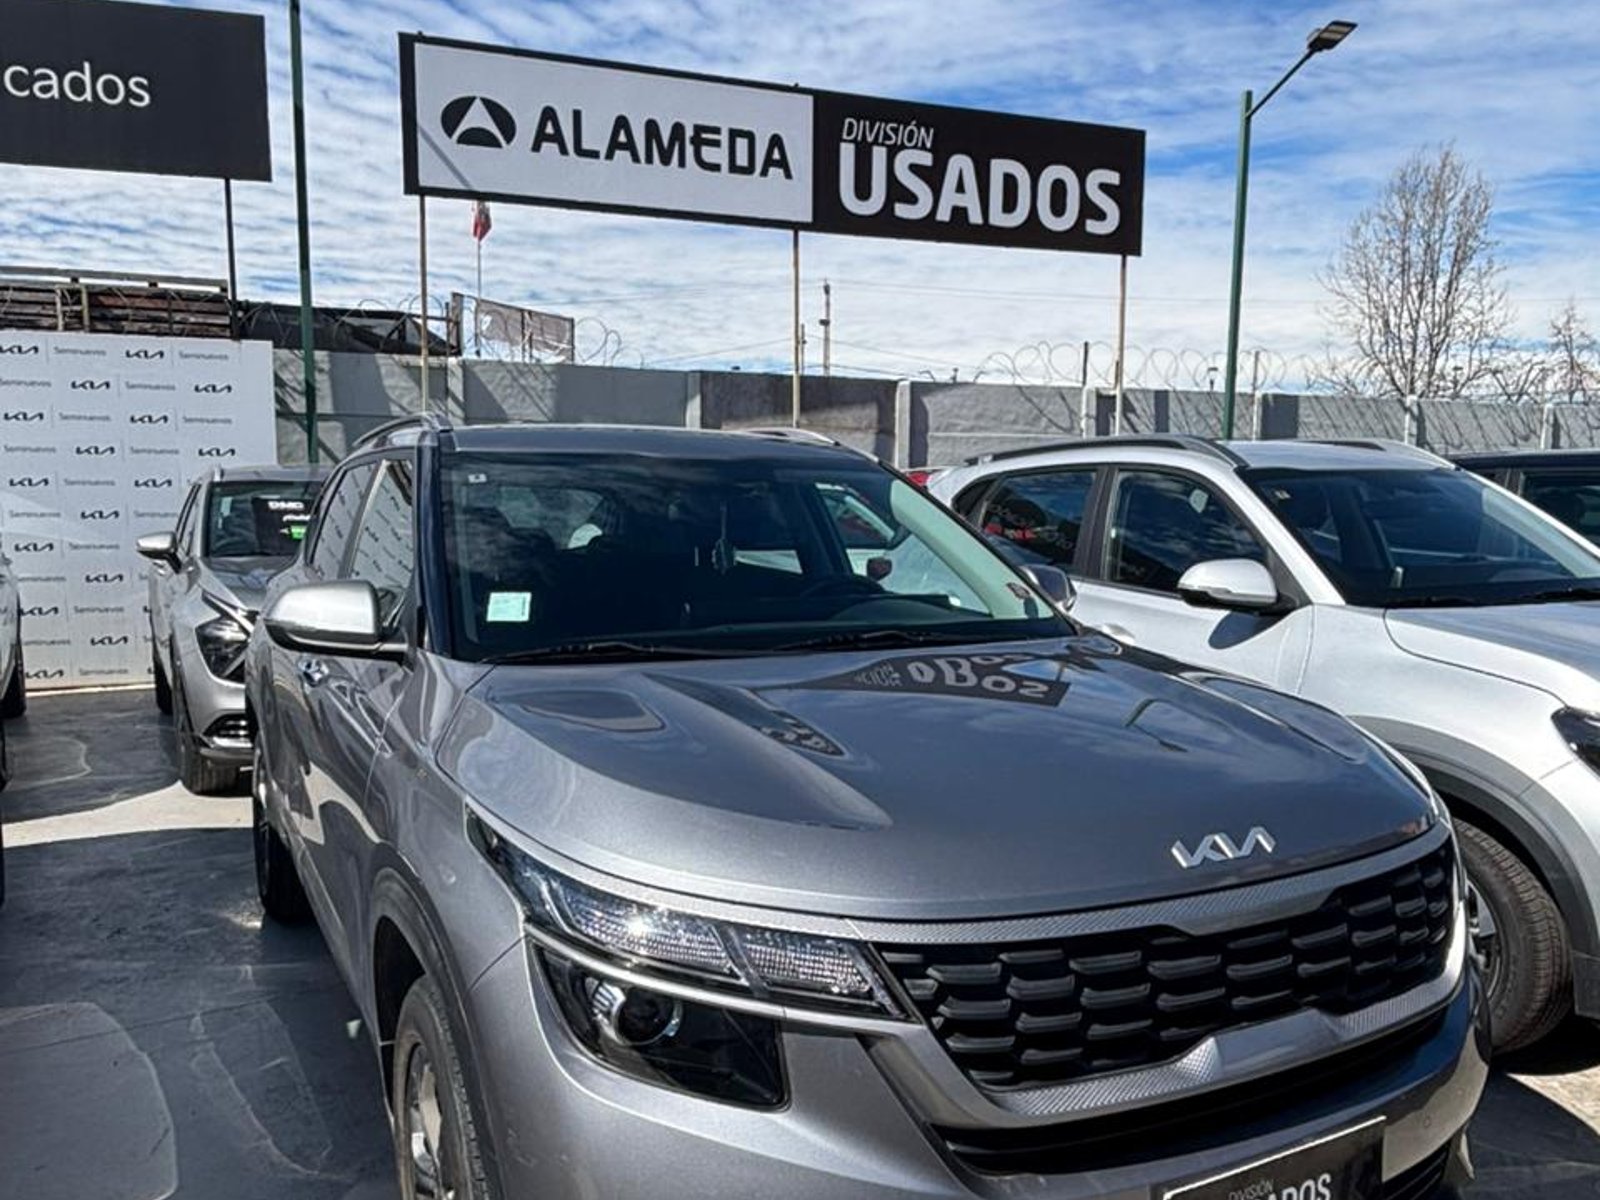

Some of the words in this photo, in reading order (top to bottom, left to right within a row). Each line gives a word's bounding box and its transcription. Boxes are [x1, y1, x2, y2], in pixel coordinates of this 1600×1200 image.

[3, 60, 151, 107] cados
[530, 105, 793, 180] ALAMEDA
[841, 117, 934, 149] DIVISIÓN
[839, 142, 1121, 235] USADOS
